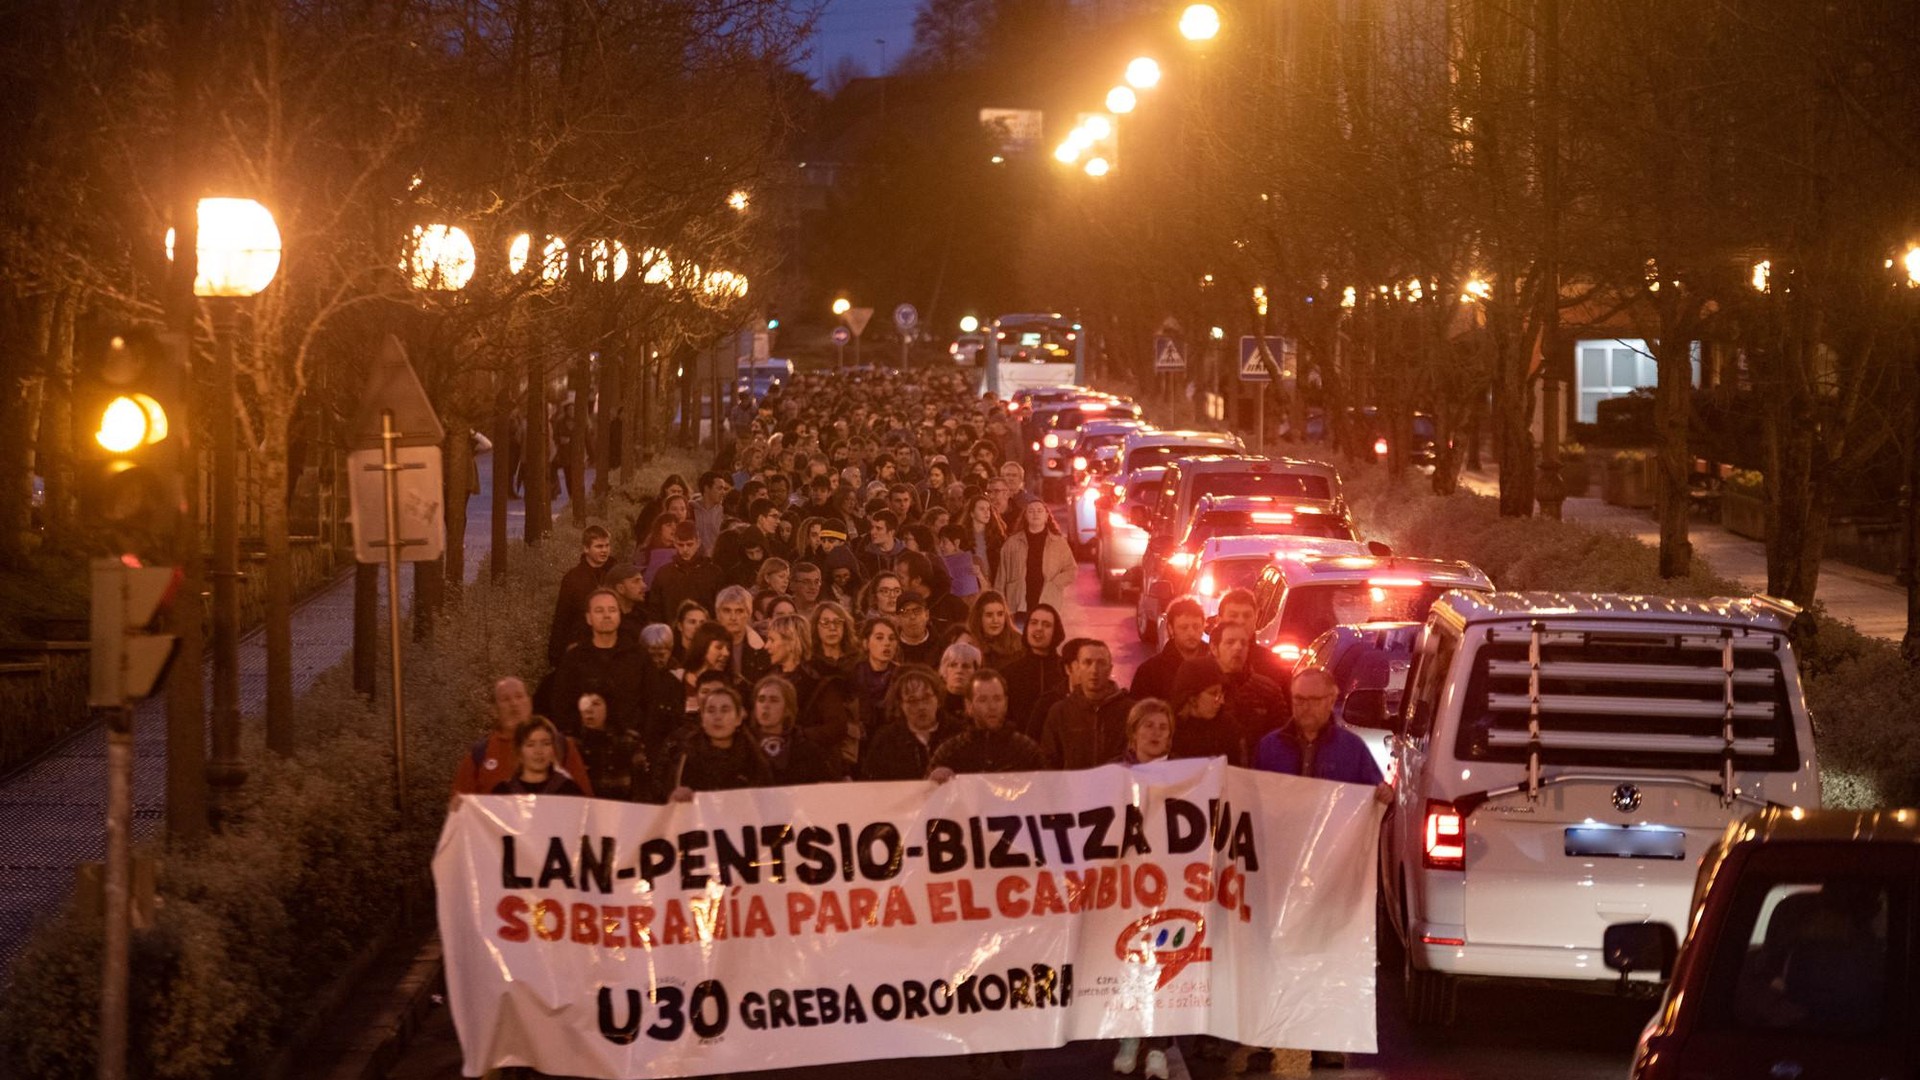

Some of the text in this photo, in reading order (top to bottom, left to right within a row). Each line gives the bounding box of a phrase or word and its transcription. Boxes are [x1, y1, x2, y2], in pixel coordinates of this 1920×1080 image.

[502, 804, 1151, 893] LAN-PENTSIO-BIZITZA
[787, 885, 916, 935] PARA
[927, 879, 991, 923] EL
[996, 862, 1167, 917] CAMBIO
[597, 979, 730, 1046] U30
[740, 984, 867, 1030] GREBA
